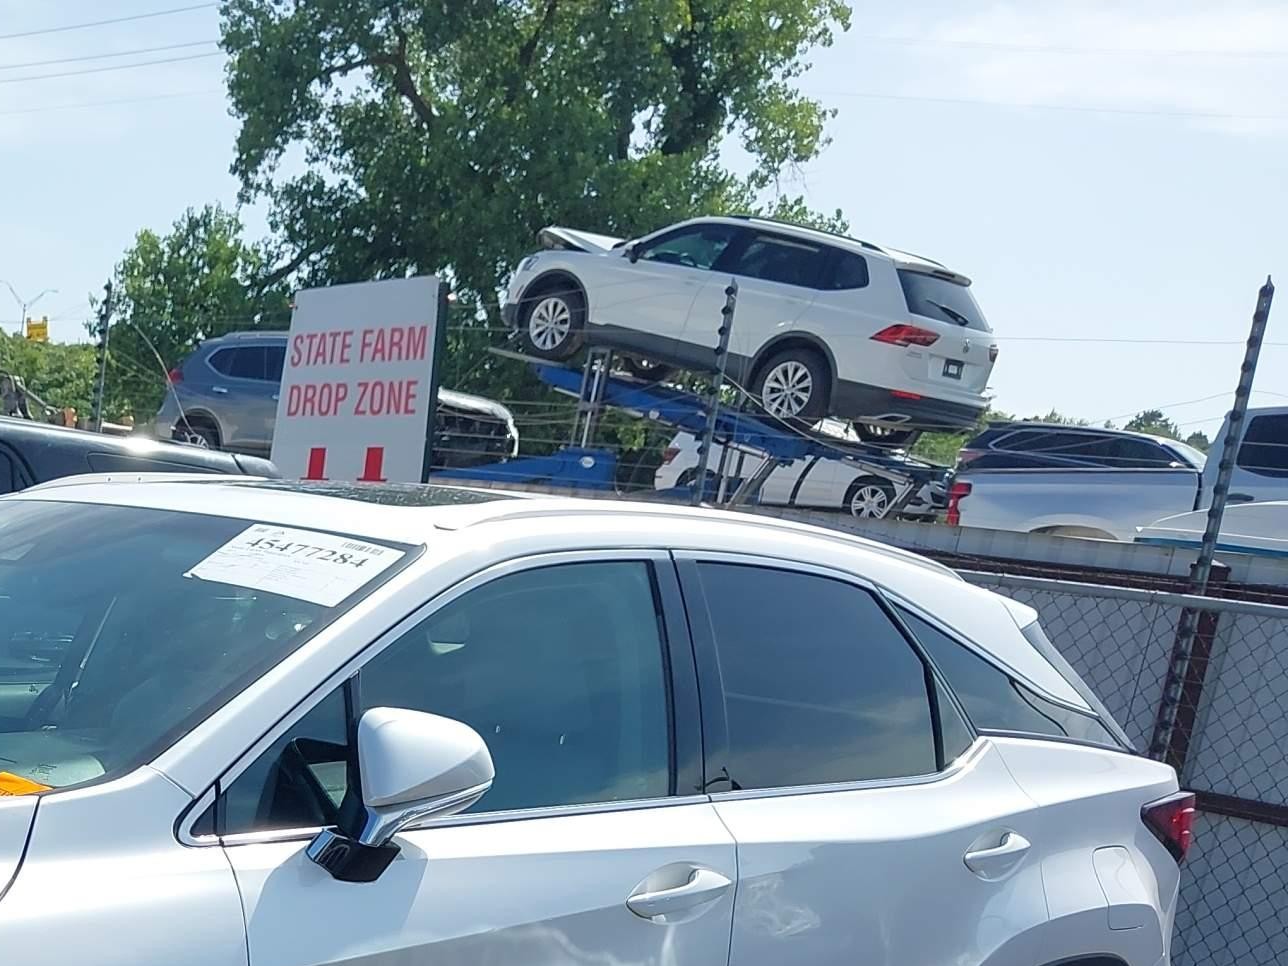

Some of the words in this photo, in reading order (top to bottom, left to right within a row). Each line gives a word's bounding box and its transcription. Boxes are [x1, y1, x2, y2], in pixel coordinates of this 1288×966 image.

[291, 331, 353, 367] STATE
[360, 326, 428, 362] FARM
[288, 383, 348, 416] DROP
[354, 380, 418, 415] ZONE
[246, 538, 369, 568] 45477284
